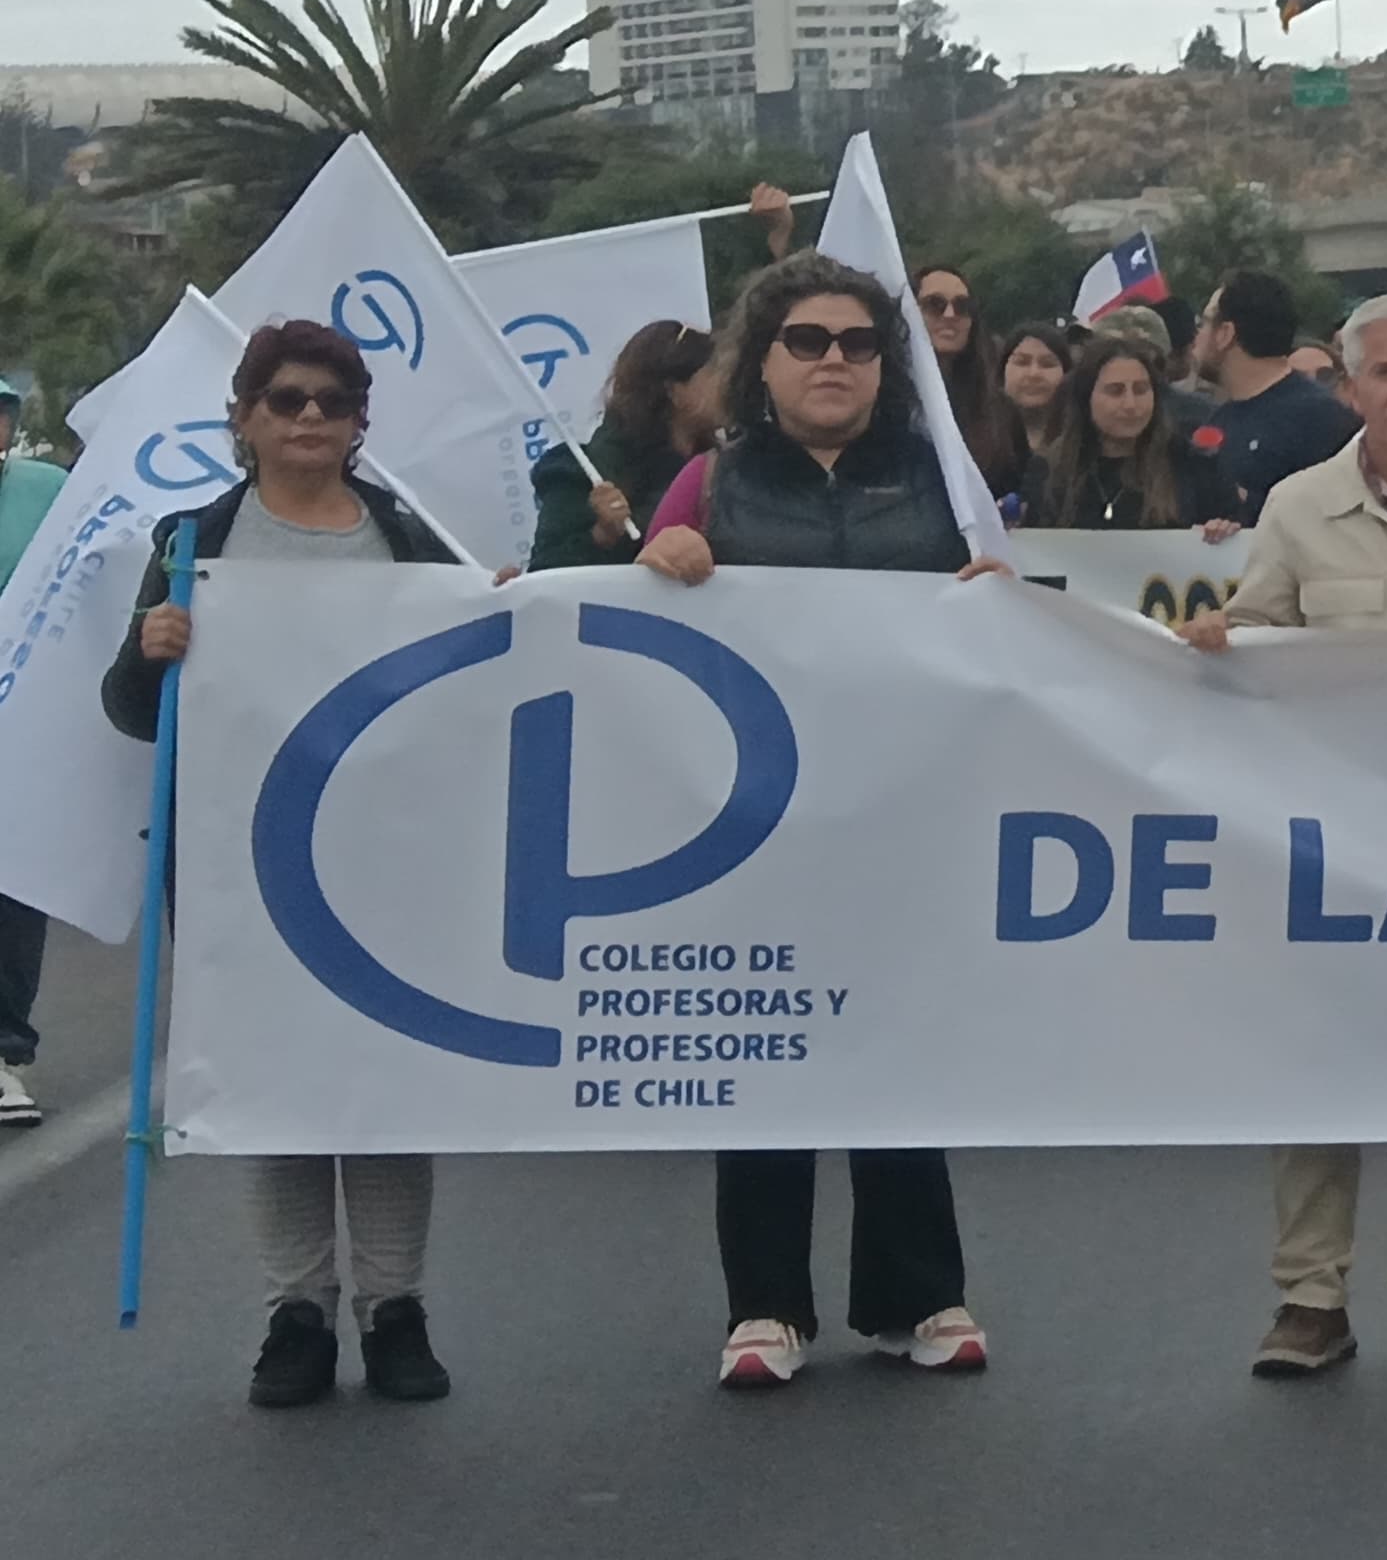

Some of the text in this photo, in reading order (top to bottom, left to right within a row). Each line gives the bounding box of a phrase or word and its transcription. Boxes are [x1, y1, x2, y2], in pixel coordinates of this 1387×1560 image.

[996, 811, 1219, 943] DE
[579, 944, 795, 972] COLEGIO DE
[577, 988, 849, 1017] PROFESORAS Y
[576, 1033, 807, 1061] PROFESORES
[574, 1078, 735, 1107] DE CHILE
